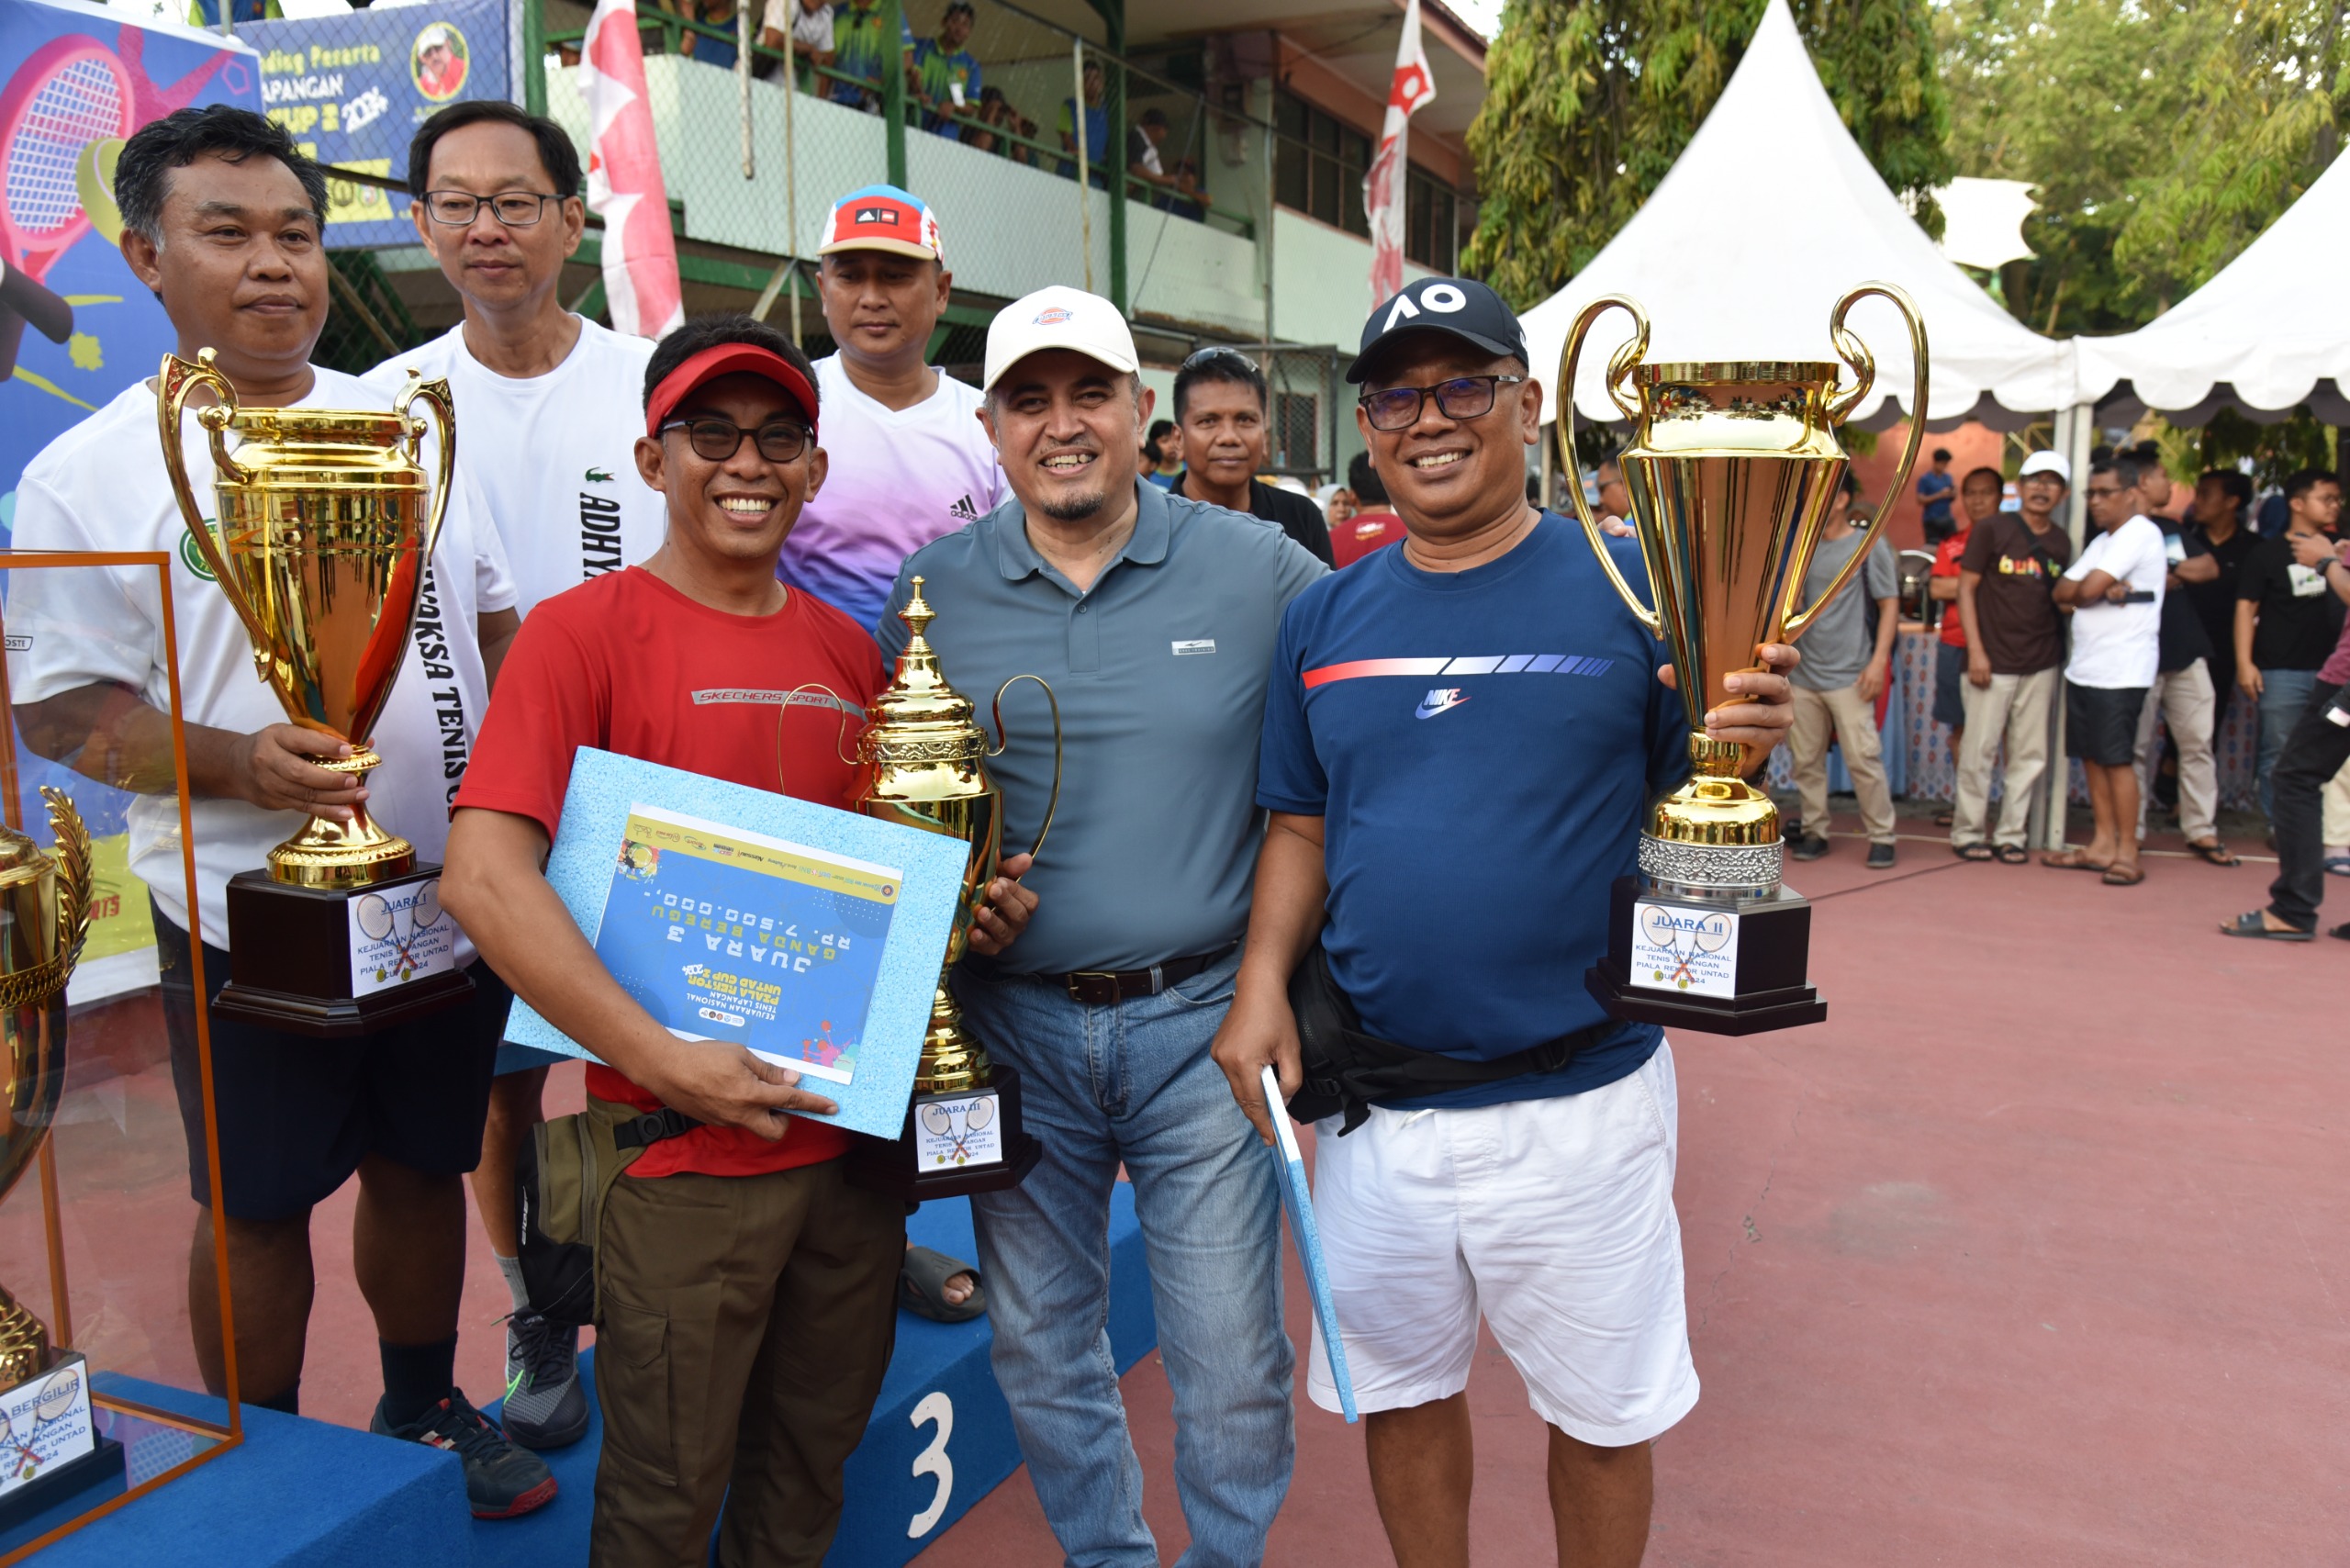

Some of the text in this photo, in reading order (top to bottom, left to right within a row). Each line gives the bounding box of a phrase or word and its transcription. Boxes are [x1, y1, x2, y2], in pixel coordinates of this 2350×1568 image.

[310, 44, 381, 69] Peserta
[341, 85, 388, 134] 2024
[580, 492, 622, 582] ADHY
[699, 691, 830, 705] SKECHERS SPORT
[1424, 689, 1461, 706] NIKE
[432, 687, 468, 780] TENIS
[739, 851, 765, 862] Nassau
[382, 895, 419, 913] JUARA
[651, 905, 835, 960] GANDA BEREGU
[1652, 915, 1723, 933] JUARA II
[358, 924, 450, 955] KEJUARAAN NASIONAL
[666, 925, 811, 973] JUARA 3
[813, 930, 851, 950] RP.
[360, 963, 385, 976] PIALA
[423, 945, 449, 958] UNTAD
[369, 950, 393, 962] TENIS
[1636, 945, 1731, 962] KEJUARAAN NASIONAL
[681, 963, 704, 976] 2024
[712, 971, 738, 985] CUP
[1636, 961, 1660, 969] PIALA
[1701, 969, 1729, 979] UNTAD
[688, 975, 780, 1006] PIALA REKTOR
[739, 978, 782, 996] UNTAD
[686, 993, 727, 1009] NASIONAL
[710, 991, 777, 1014] TENIS LAPANGAN
[729, 1004, 776, 1021] KEJUARAAN
[932, 1103, 980, 1116] JUARA III
[956, 1137, 986, 1146] ANGAN
[11, 1377, 80, 1417] BERGILIR
[32, 1406, 85, 1433] NASIONAL
[50, 1426, 86, 1447] UNTAD
[907, 1391, 954, 1539] 3
